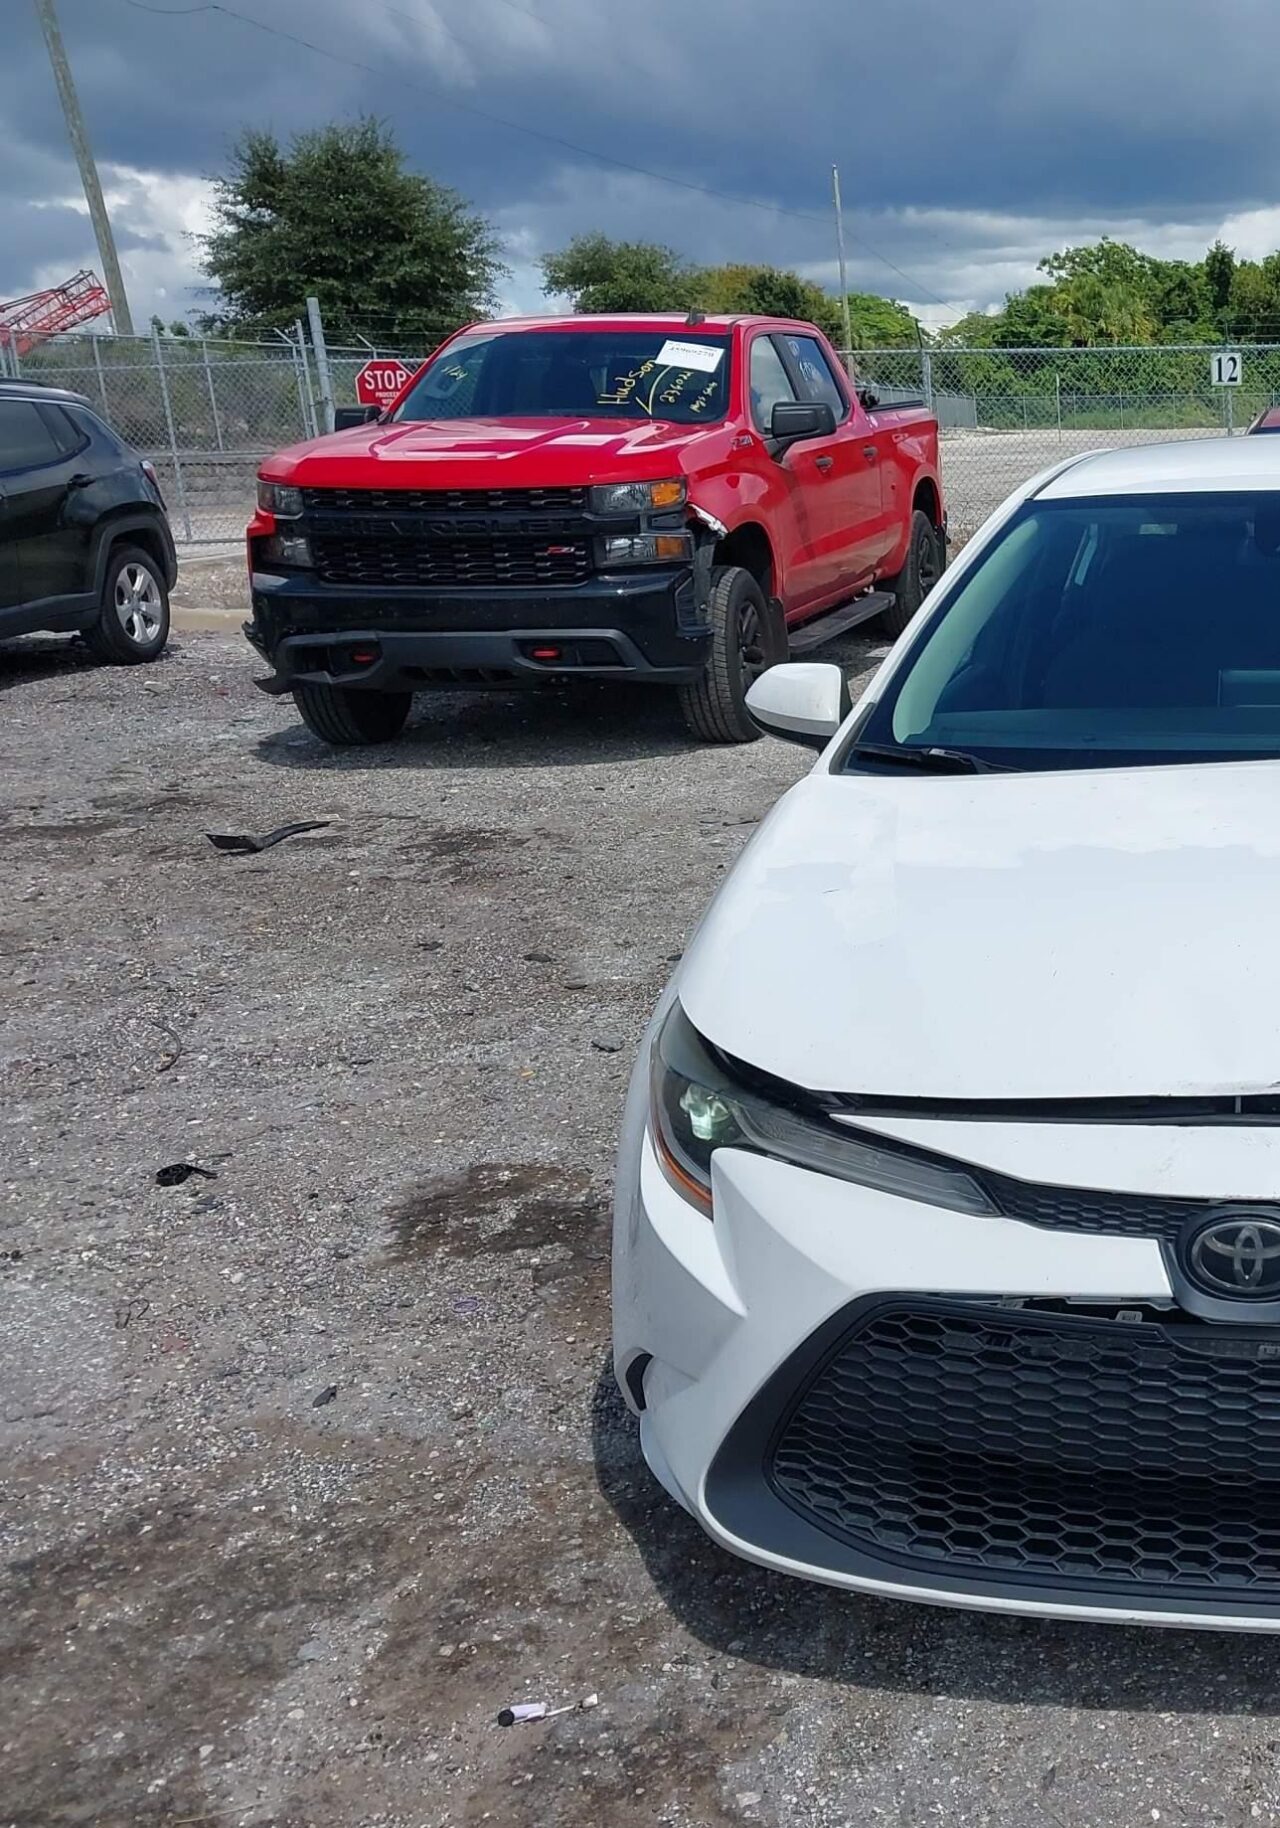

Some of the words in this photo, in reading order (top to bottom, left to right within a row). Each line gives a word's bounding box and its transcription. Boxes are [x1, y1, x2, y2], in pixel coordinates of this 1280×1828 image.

[364, 370, 408, 390] STOP
[597, 360, 656, 405] Hudson
[1215, 356, 1238, 383] 12
